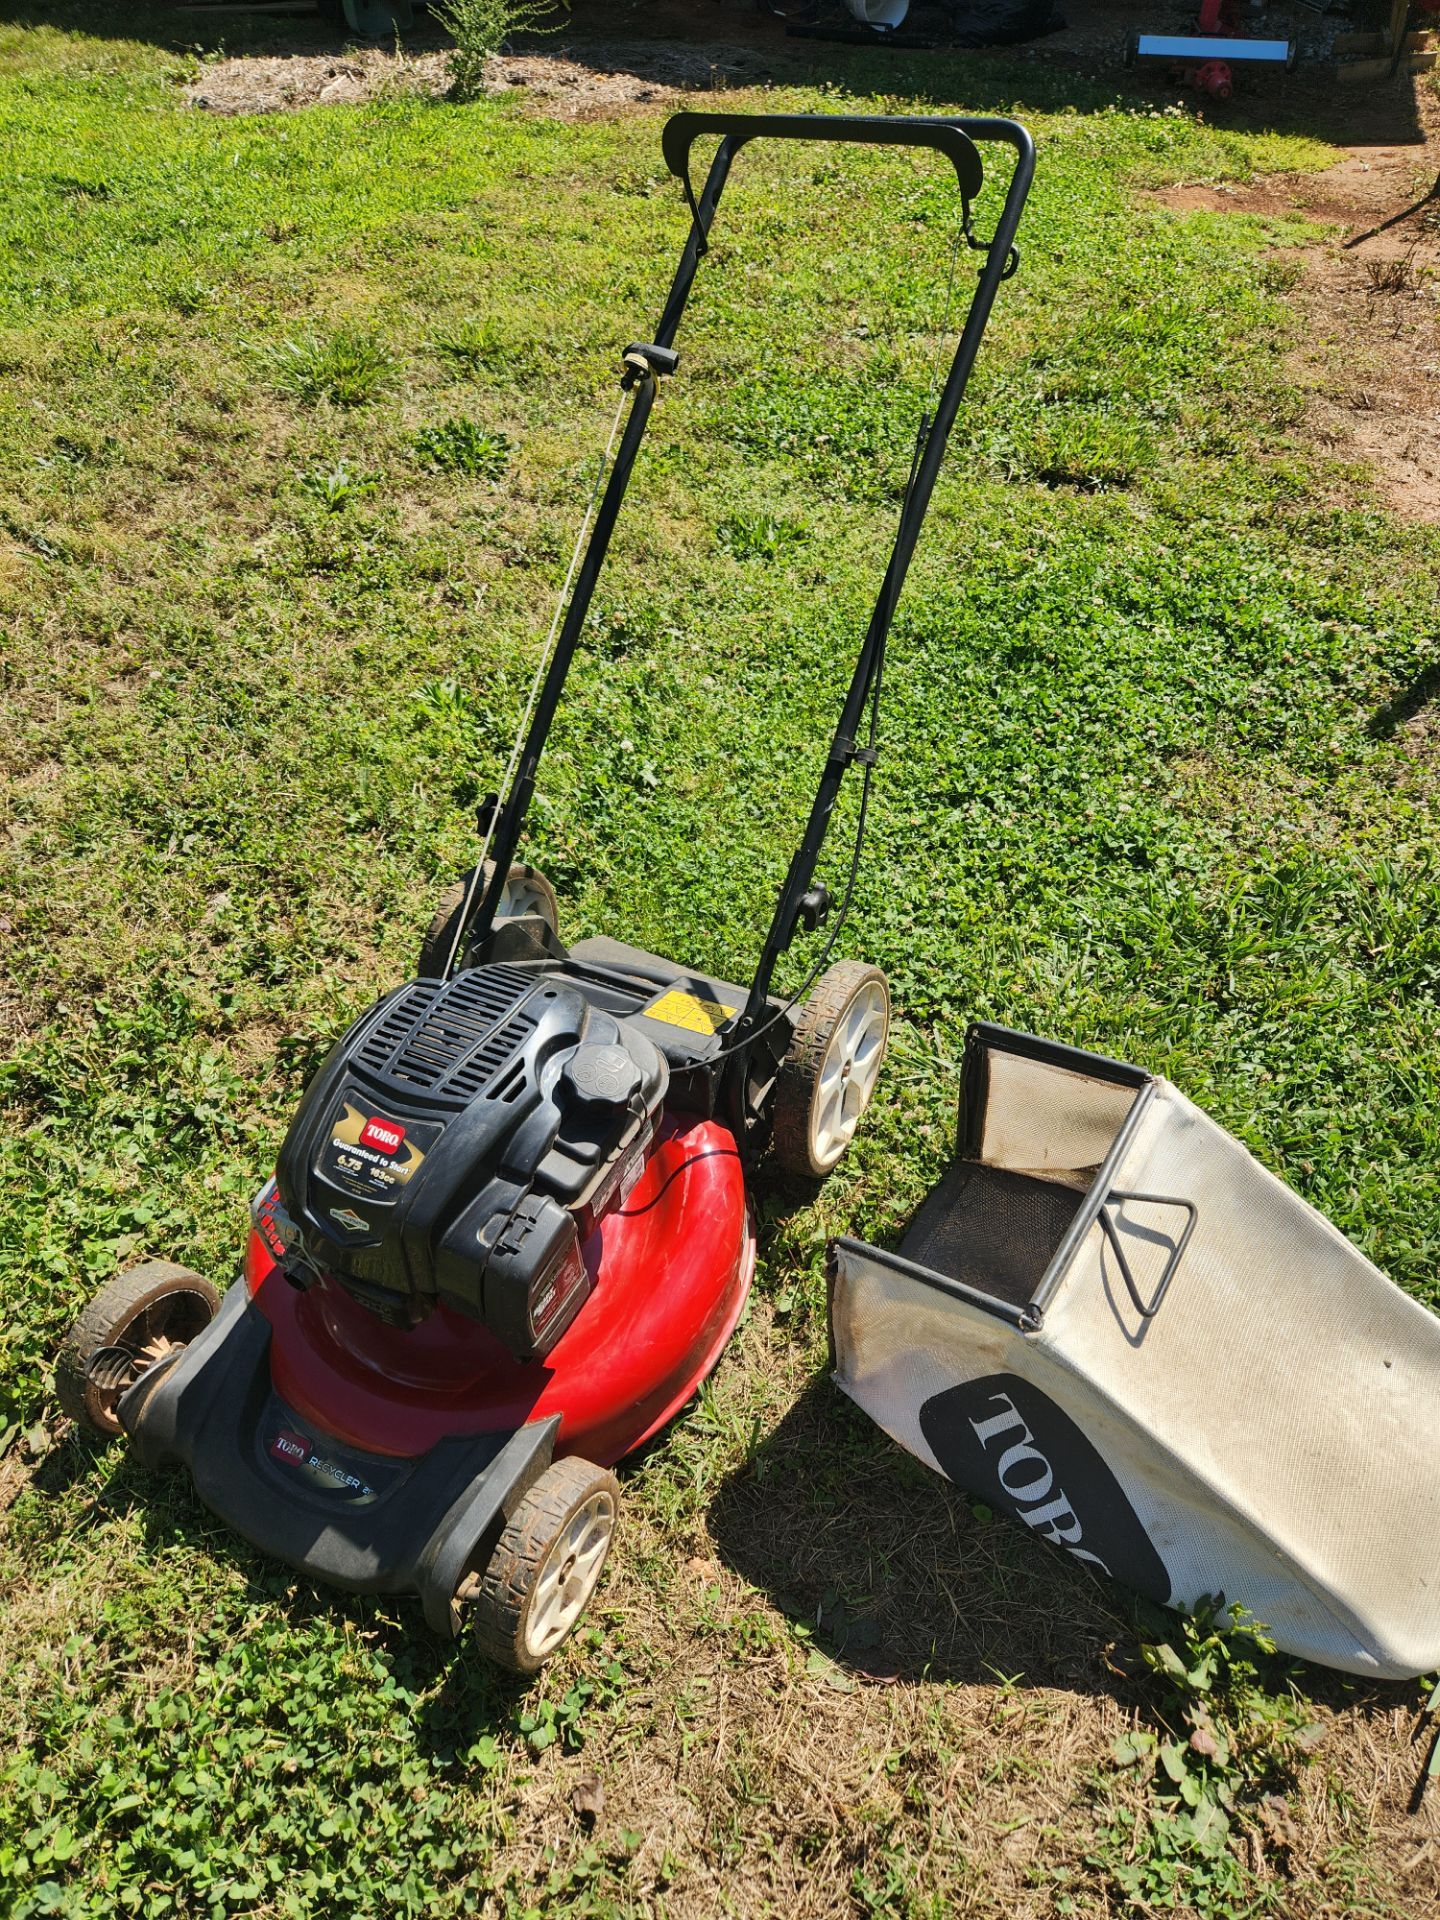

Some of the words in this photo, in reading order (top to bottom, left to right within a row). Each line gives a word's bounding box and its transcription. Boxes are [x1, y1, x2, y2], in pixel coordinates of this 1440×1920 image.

[366, 1124, 399, 1146] TORO
[333, 1138, 380, 1163] Guaranteed
[380, 1157, 389, 1167] to
[389, 1161, 409, 1175] Start
[337, 1154, 363, 1171] 6.75
[276, 1437, 304, 1459] TORO
[309, 1456, 360, 1488] RECYCLER
[968, 1392, 1113, 1578] TOR
